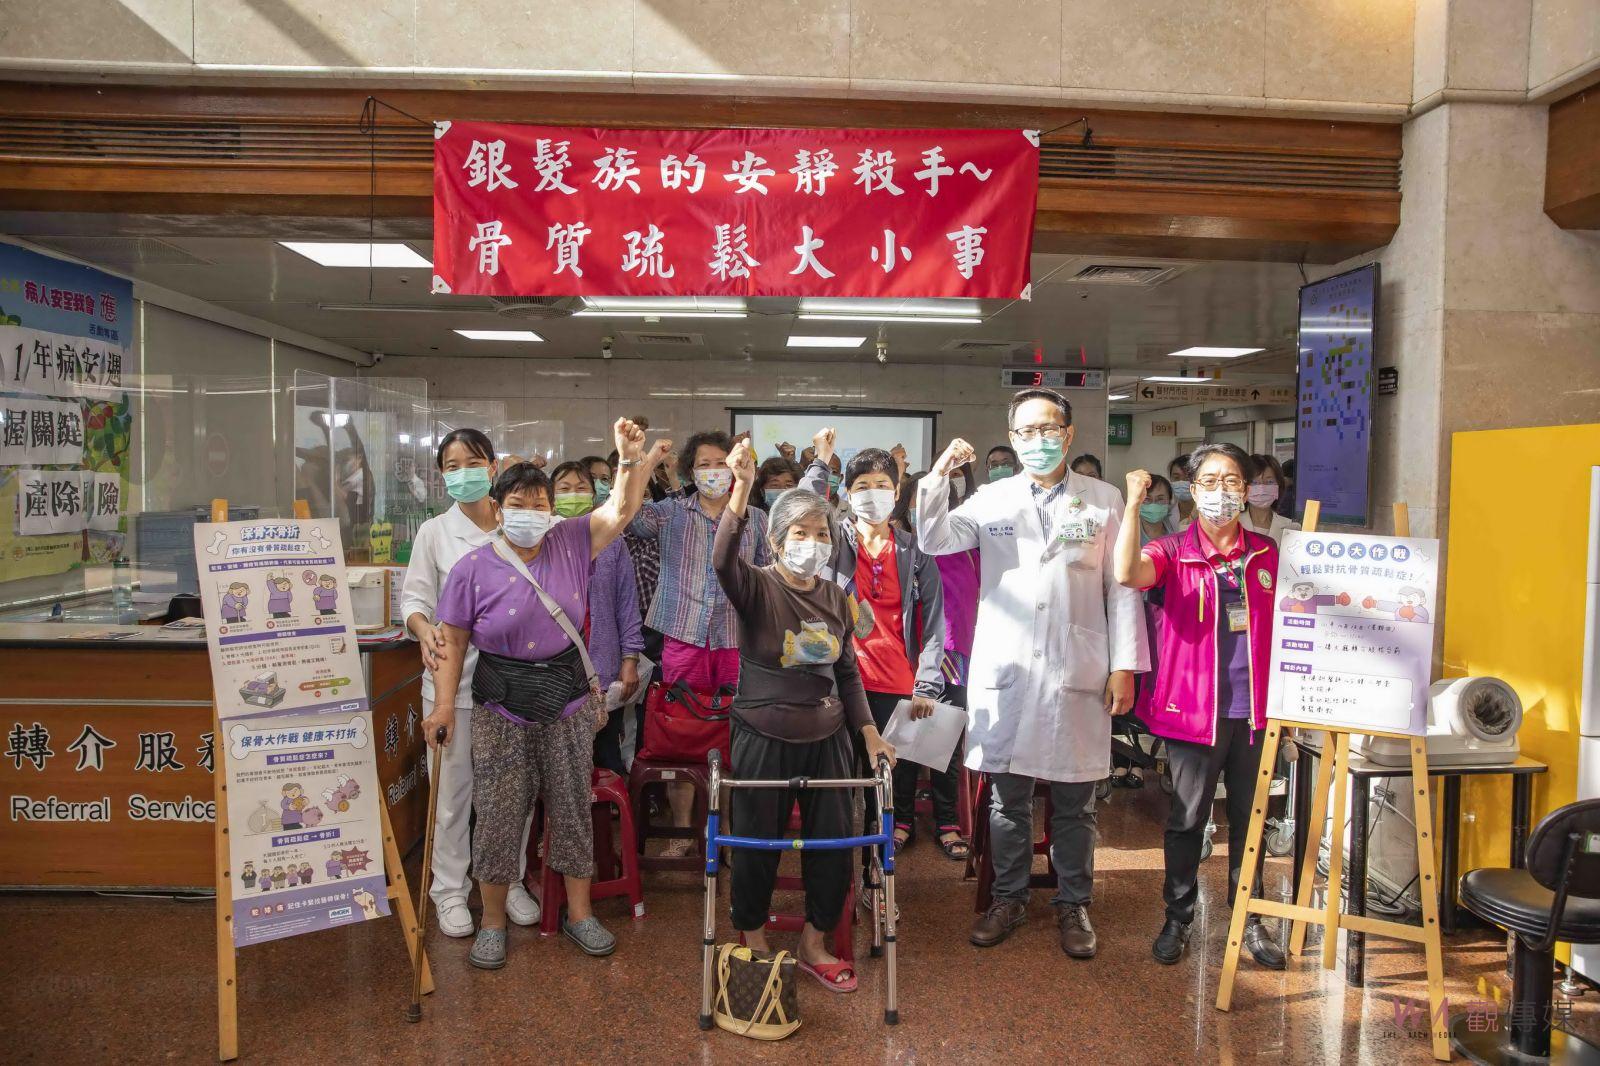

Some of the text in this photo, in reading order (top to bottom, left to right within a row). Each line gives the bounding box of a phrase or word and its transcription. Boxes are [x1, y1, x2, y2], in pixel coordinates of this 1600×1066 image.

[468, 219, 988, 282] 骨質疏鬆大小事
[25, 280, 95, 316] 病人安全我會
[1034, 371, 1042, 386] 3
[3, 407, 83, 448] 握關鍵
[25, 479, 119, 518] 產除險
[240, 524, 300, 541] 保骨不骨折
[1308, 542, 1407, 561] 保骨大作戰
[1300, 563, 1414, 581] 輕鬆對抗骨質疏鬆症!
[241, 728, 357, 748] 保骨大作戰 健康不打折
[387, 764, 417, 810] Referral
[11, 796, 110, 822] Referral
